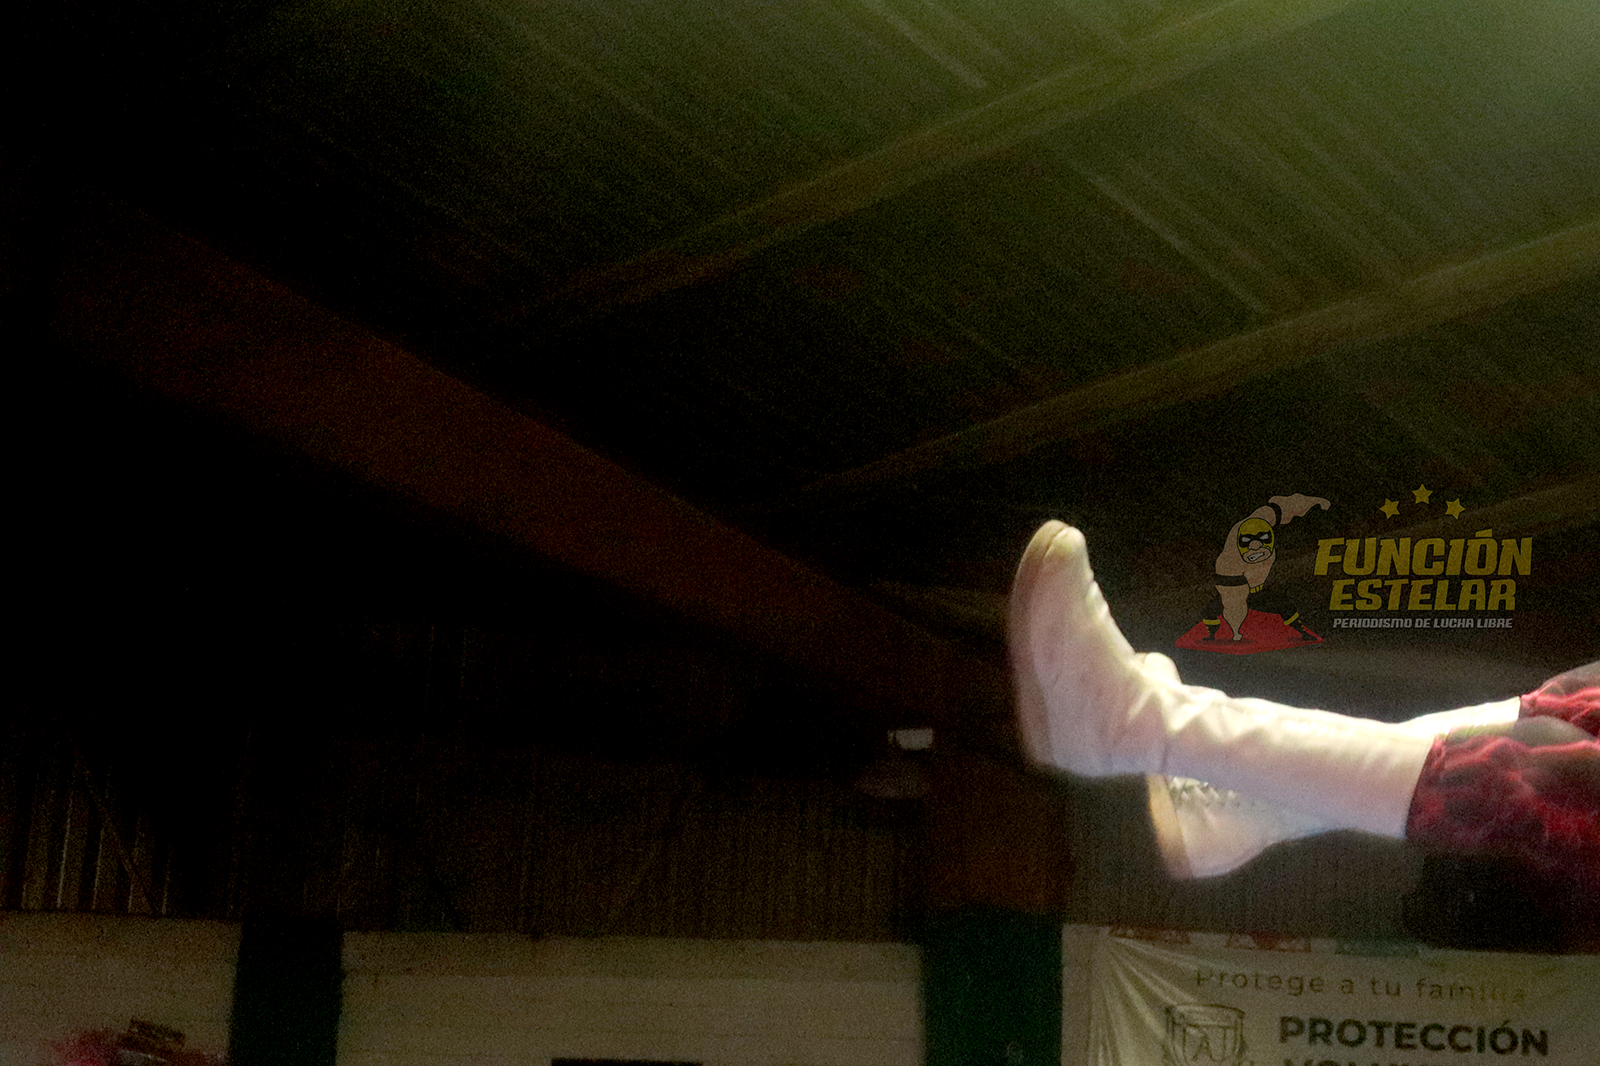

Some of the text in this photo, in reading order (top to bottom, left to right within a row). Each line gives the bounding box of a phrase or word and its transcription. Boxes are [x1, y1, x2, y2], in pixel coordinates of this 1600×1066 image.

[1195, 969, 1325, 997] Protege
[1340, 977, 1355, 993] a
[1370, 978, 1401, 997] tu
[1279, 1016, 1550, 1057] PROTECCIÓN
